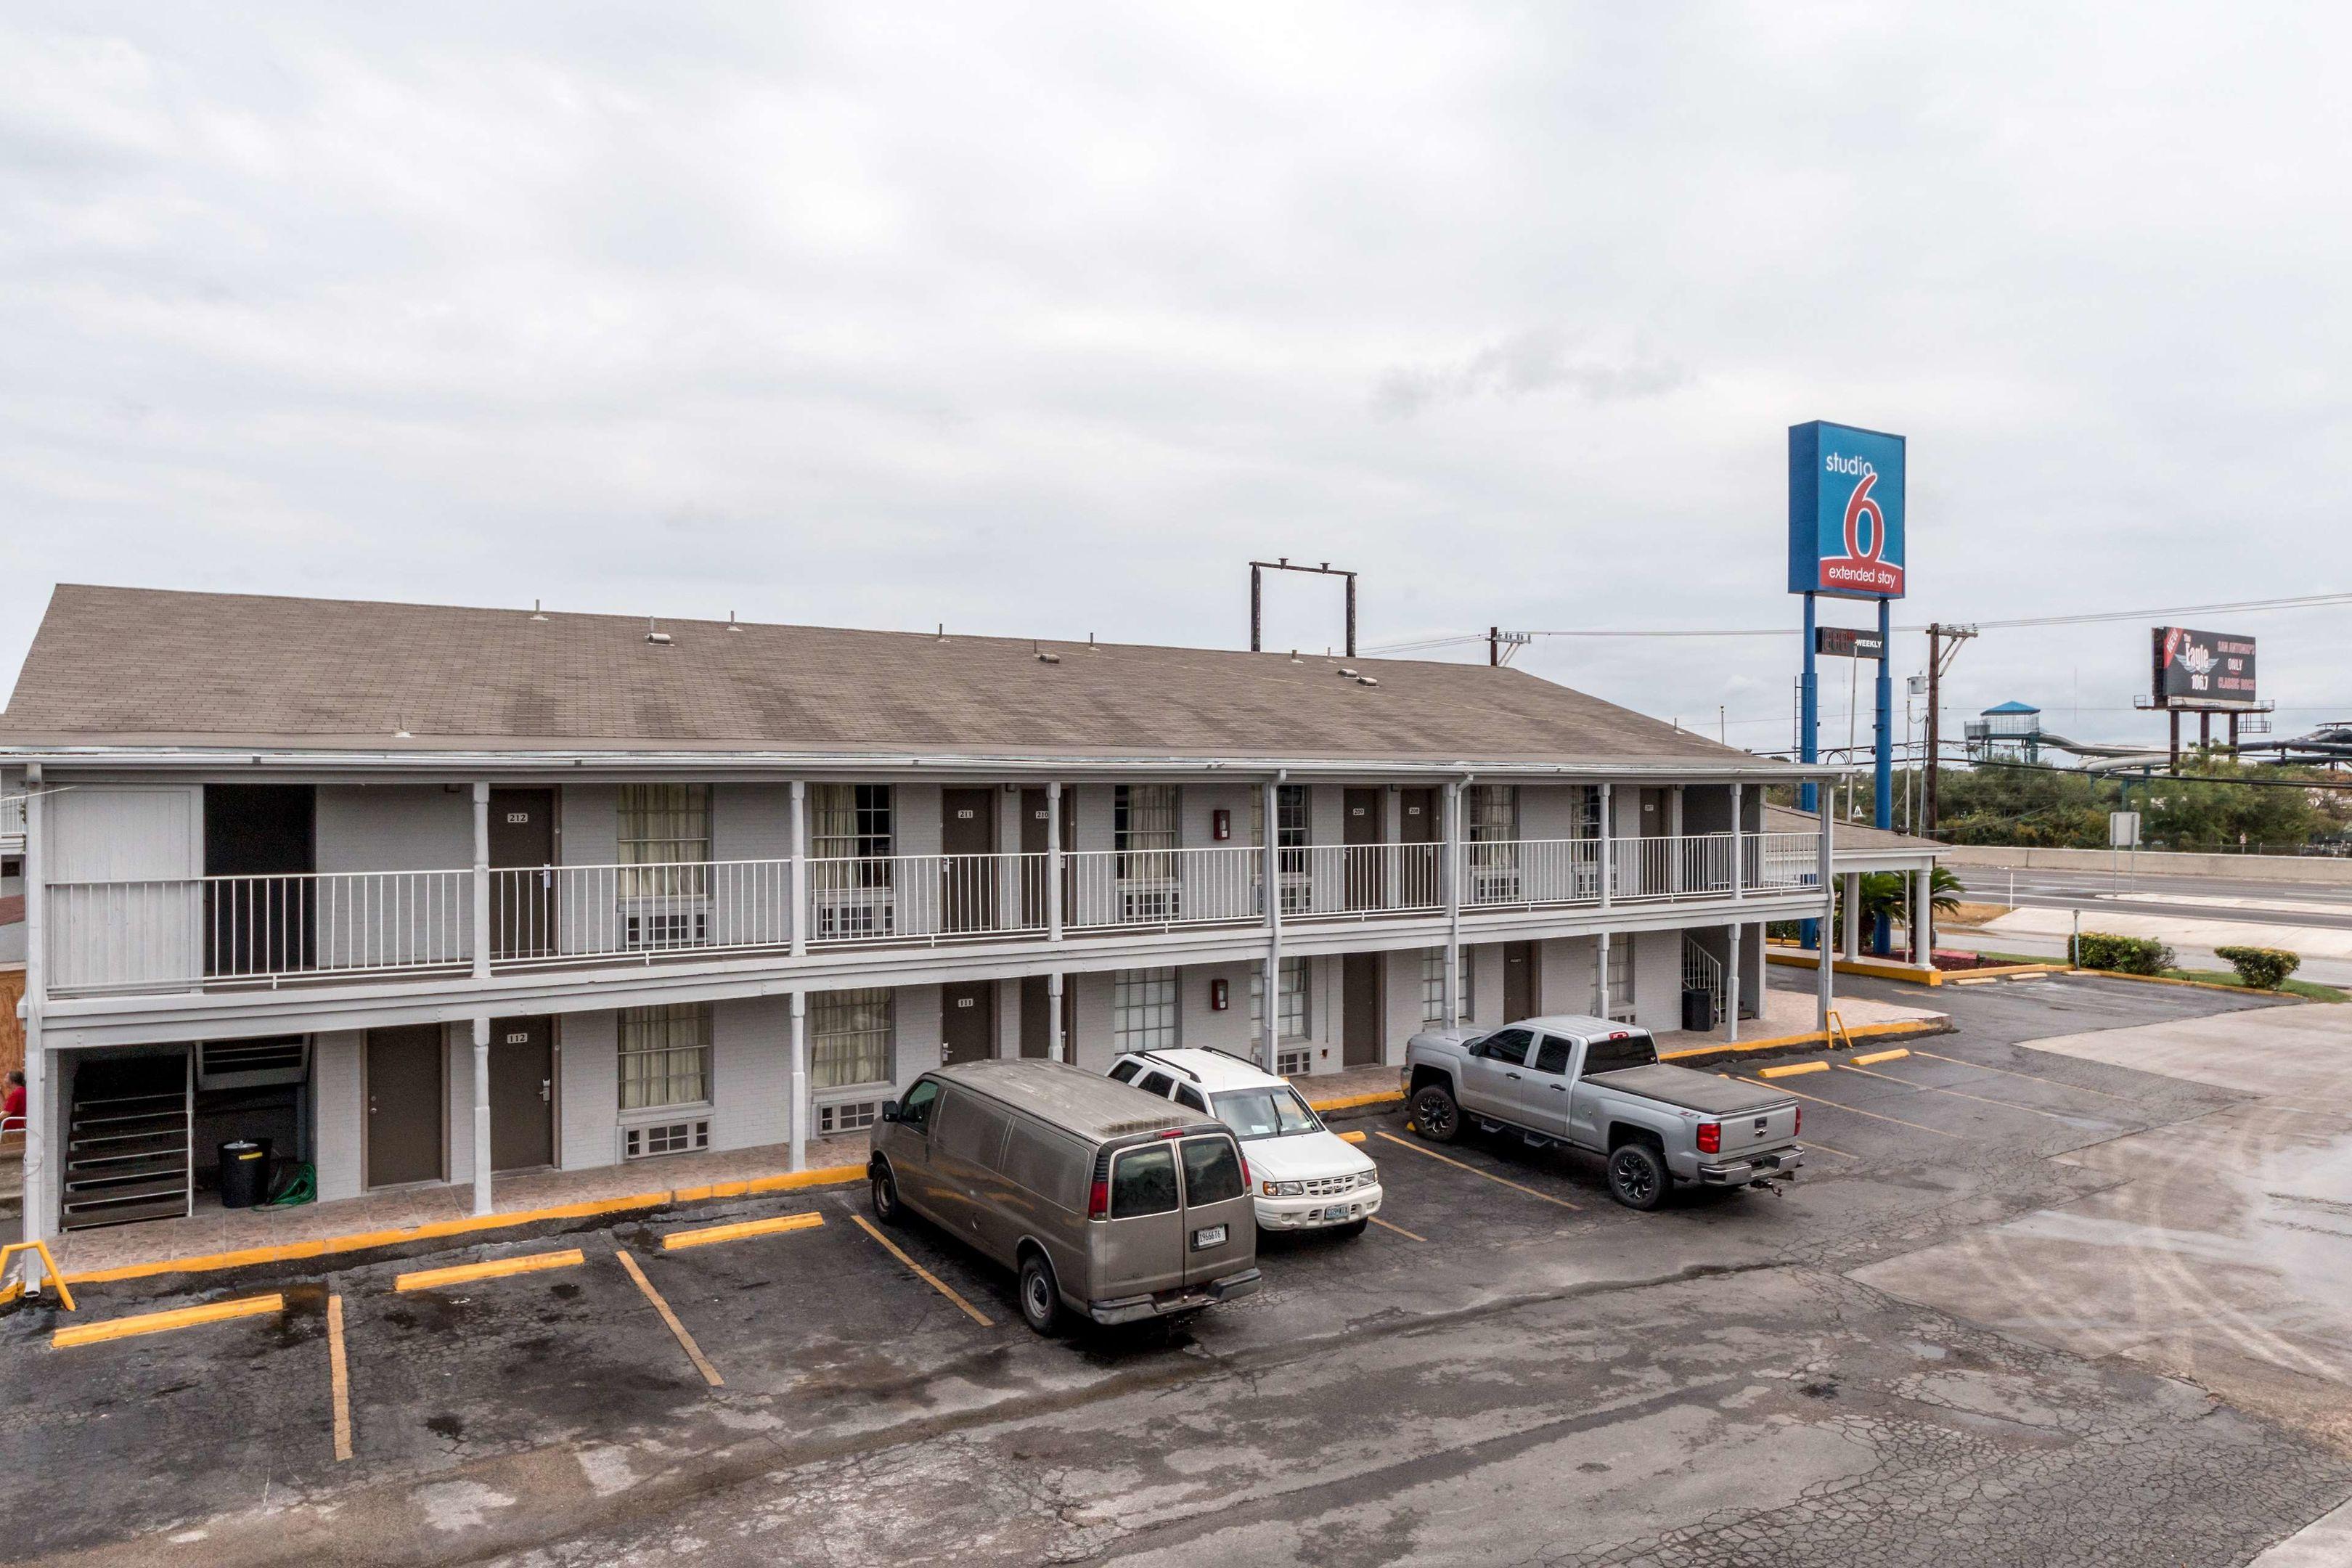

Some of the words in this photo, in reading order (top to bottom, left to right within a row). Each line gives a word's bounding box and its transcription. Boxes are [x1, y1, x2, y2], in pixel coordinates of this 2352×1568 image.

[1826, 452, 1873, 476] studio
[1843, 472, 1885, 562] 6
[1829, 566, 1875, 583] extended
[1877, 571, 1896, 589] stay
[1855, 640, 1882, 649] WEEKLY
[2166, 628, 2179, 653] NEW
[2185, 642, 2209, 671] Eagle
[2228, 658, 2243, 671] ONLY
[2192, 674, 2209, 691] 106.7
[510, 1034, 526, 1042] 112
